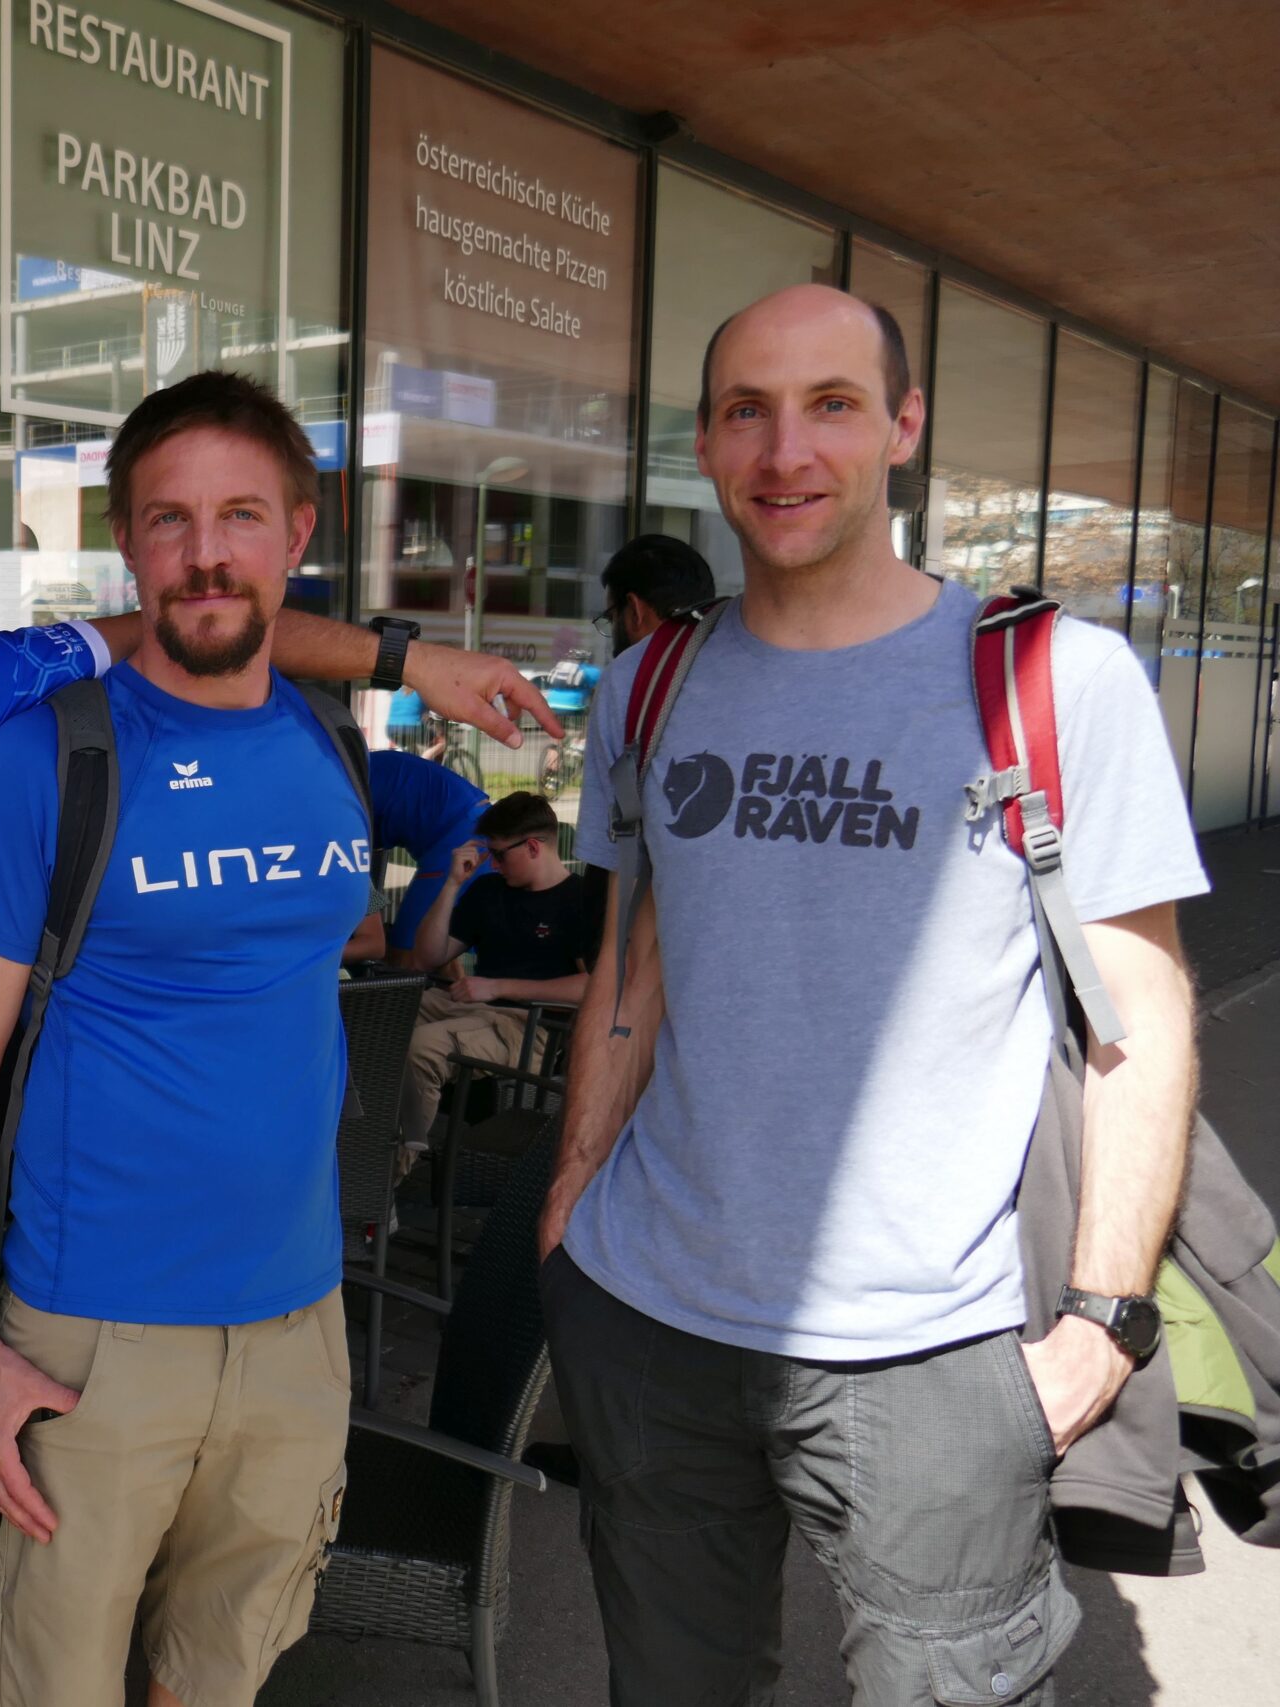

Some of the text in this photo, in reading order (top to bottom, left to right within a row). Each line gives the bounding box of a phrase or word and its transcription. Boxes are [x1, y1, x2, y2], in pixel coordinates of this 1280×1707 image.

[30, 0, 269, 120] RESTAURANT
[58, 133, 246, 230] PARKBAD
[416, 133, 610, 236] österreichische Küche
[111, 212, 200, 280] LINZ
[416, 195, 607, 291] hausgemachte Pizzen
[445, 268, 581, 339] köstliche Salate
[170, 776, 213, 790] erima
[740, 752, 893, 803] FJÄLL
[733, 796, 920, 851] RÄVEN
[131, 839, 369, 894] LINZ AG
